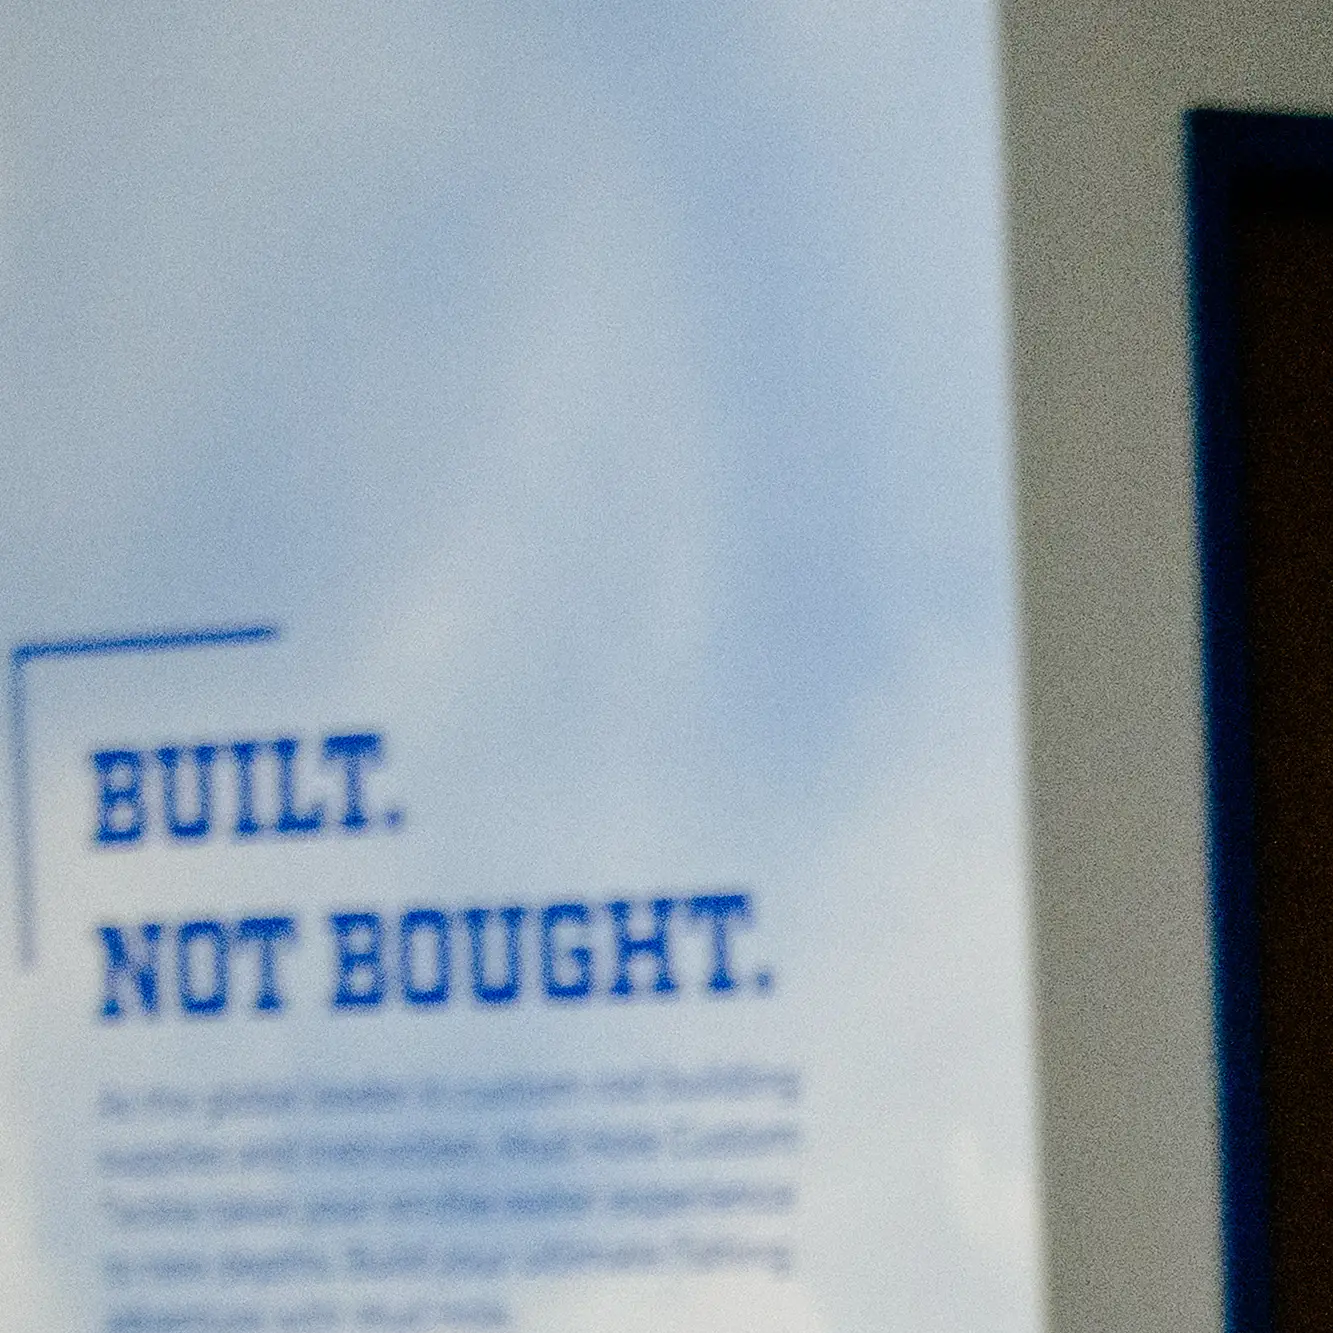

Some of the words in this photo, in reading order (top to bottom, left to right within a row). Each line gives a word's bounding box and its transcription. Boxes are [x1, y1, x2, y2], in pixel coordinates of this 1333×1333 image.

[92, 733, 404, 847] BUILT.
[97, 914, 296, 1022] NOT
[328, 893, 774, 1010] BOUGHT.
